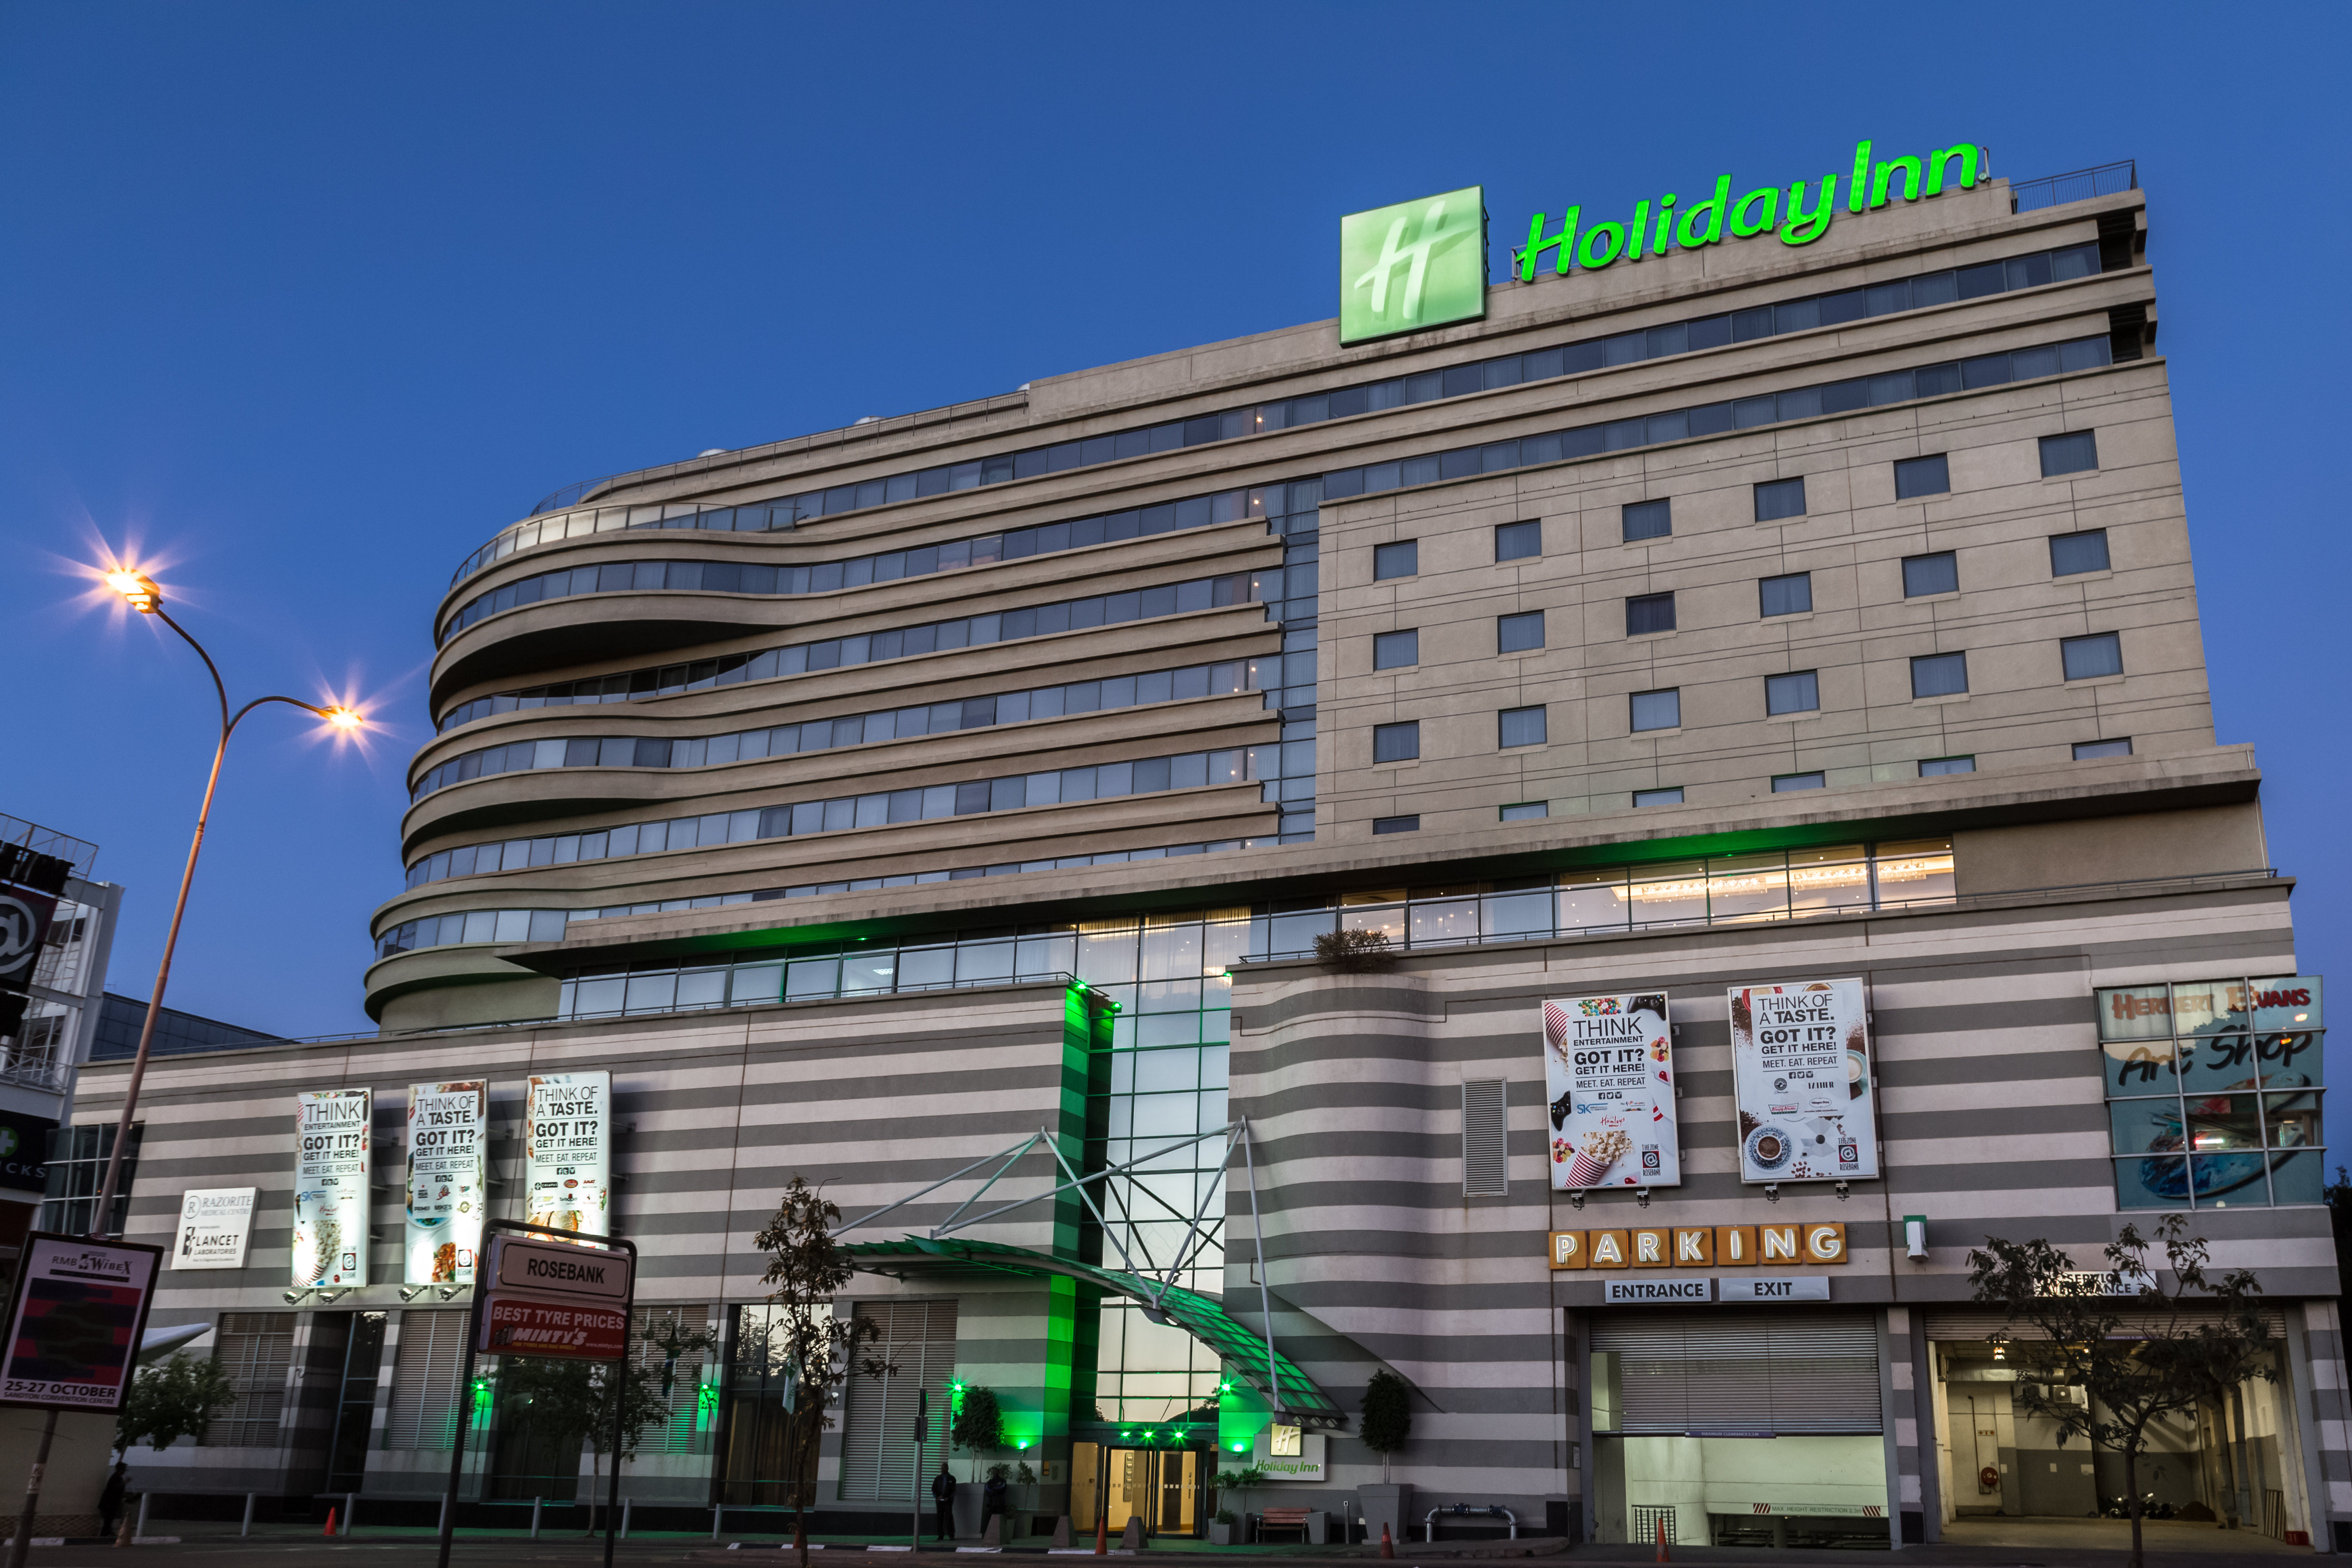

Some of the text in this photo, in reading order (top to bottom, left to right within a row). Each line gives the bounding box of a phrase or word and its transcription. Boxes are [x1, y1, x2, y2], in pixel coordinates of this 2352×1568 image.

[1516, 139, 1978, 283] Holiday Inn
[1758, 994, 1833, 1011] THINK OF
[2225, 985, 2310, 1012] EVANS
[1760, 1008, 1834, 1025] A TASTE.
[1573, 1016, 1643, 1038] THINK
[1760, 1026, 1836, 1044] GOT IT?
[1574, 1036, 1644, 1046] ENTERTAINMENT
[1762, 1042, 1837, 1054] GET IT HERE!
[1574, 1048, 1644, 1065] GOT IT?
[1763, 1056, 1838, 1068] MEET. EAT. REPEAT
[2118, 1024, 2313, 1086] Art Shop
[1575, 1063, 1645, 1075] GET IT HERE!
[1576, 1077, 1646, 1089] MEET. EAT. REPEAT
[537, 1086, 598, 1102] THINK OF
[305, 1100, 361, 1122] THINK
[417, 1095, 476, 1112] THINK OF
[536, 1101, 598, 1116] A TASTE.
[1577, 1103, 1591, 1115] SK
[304, 1120, 361, 1131] ENTERTAINMENT
[416, 1110, 475, 1126] A TASTE.
[1600, 1114, 1625, 1127] Hamleys
[536, 1120, 598, 1138] GOT IT?
[304, 1134, 359, 1150] GOT IT?
[416, 1129, 475, 1146] GOT IT?
[535, 1137, 597, 1148] GET IT HERE!
[303, 1149, 359, 1161] GET IT HERE!
[416, 1145, 474, 1156] GET IT HERE!
[535, 1152, 597, 1163] MEET. EAT. REPEAT
[303, 1164, 359, 1175] MEET. EAT. REPEAT
[415, 1160, 474, 1170] MEET. EAT. REPEAT
[202, 1196, 253, 1207] RAZORITE
[196, 1235, 239, 1246] LANCET
[1556, 1227, 1841, 1264] PARKING
[52, 1256, 78, 1266] RMB
[527, 1258, 605, 1284] ROSEBANK
[1612, 1283, 1704, 1299] ENTRANCE
[1754, 1282, 1792, 1296] EXIT
[493, 1306, 624, 1330] BEST TYRE PRICES
[513, 1327, 588, 1346] MINTY'S
[4, 1380, 117, 1398] 25-27 OCTOBER
[41, 1394, 87, 1402] CONVENTION
[1256, 1459, 1319, 1475] Holiday Inn
